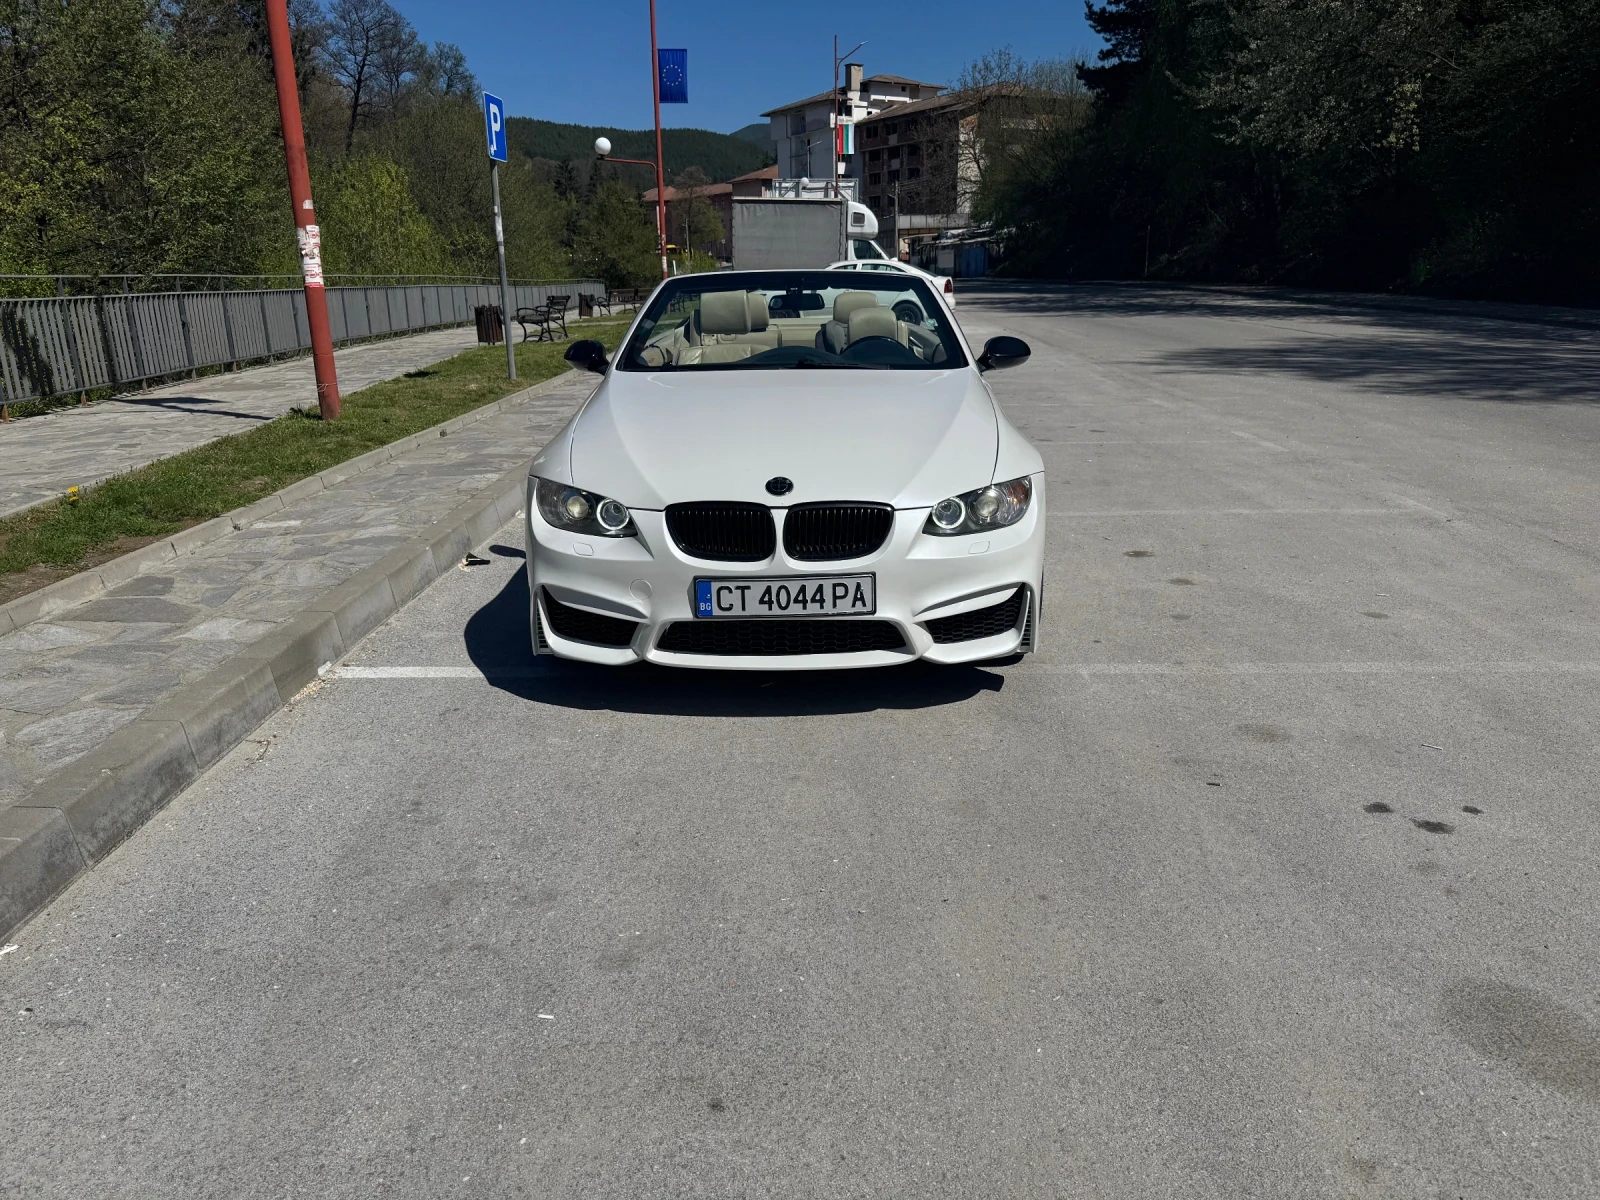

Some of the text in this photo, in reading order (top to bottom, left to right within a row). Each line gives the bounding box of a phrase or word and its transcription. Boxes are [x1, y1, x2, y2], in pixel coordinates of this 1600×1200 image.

[489, 102, 501, 151] P
[699, 602, 712, 611] BG
[716, 581, 867, 612] CT 4044 PA
